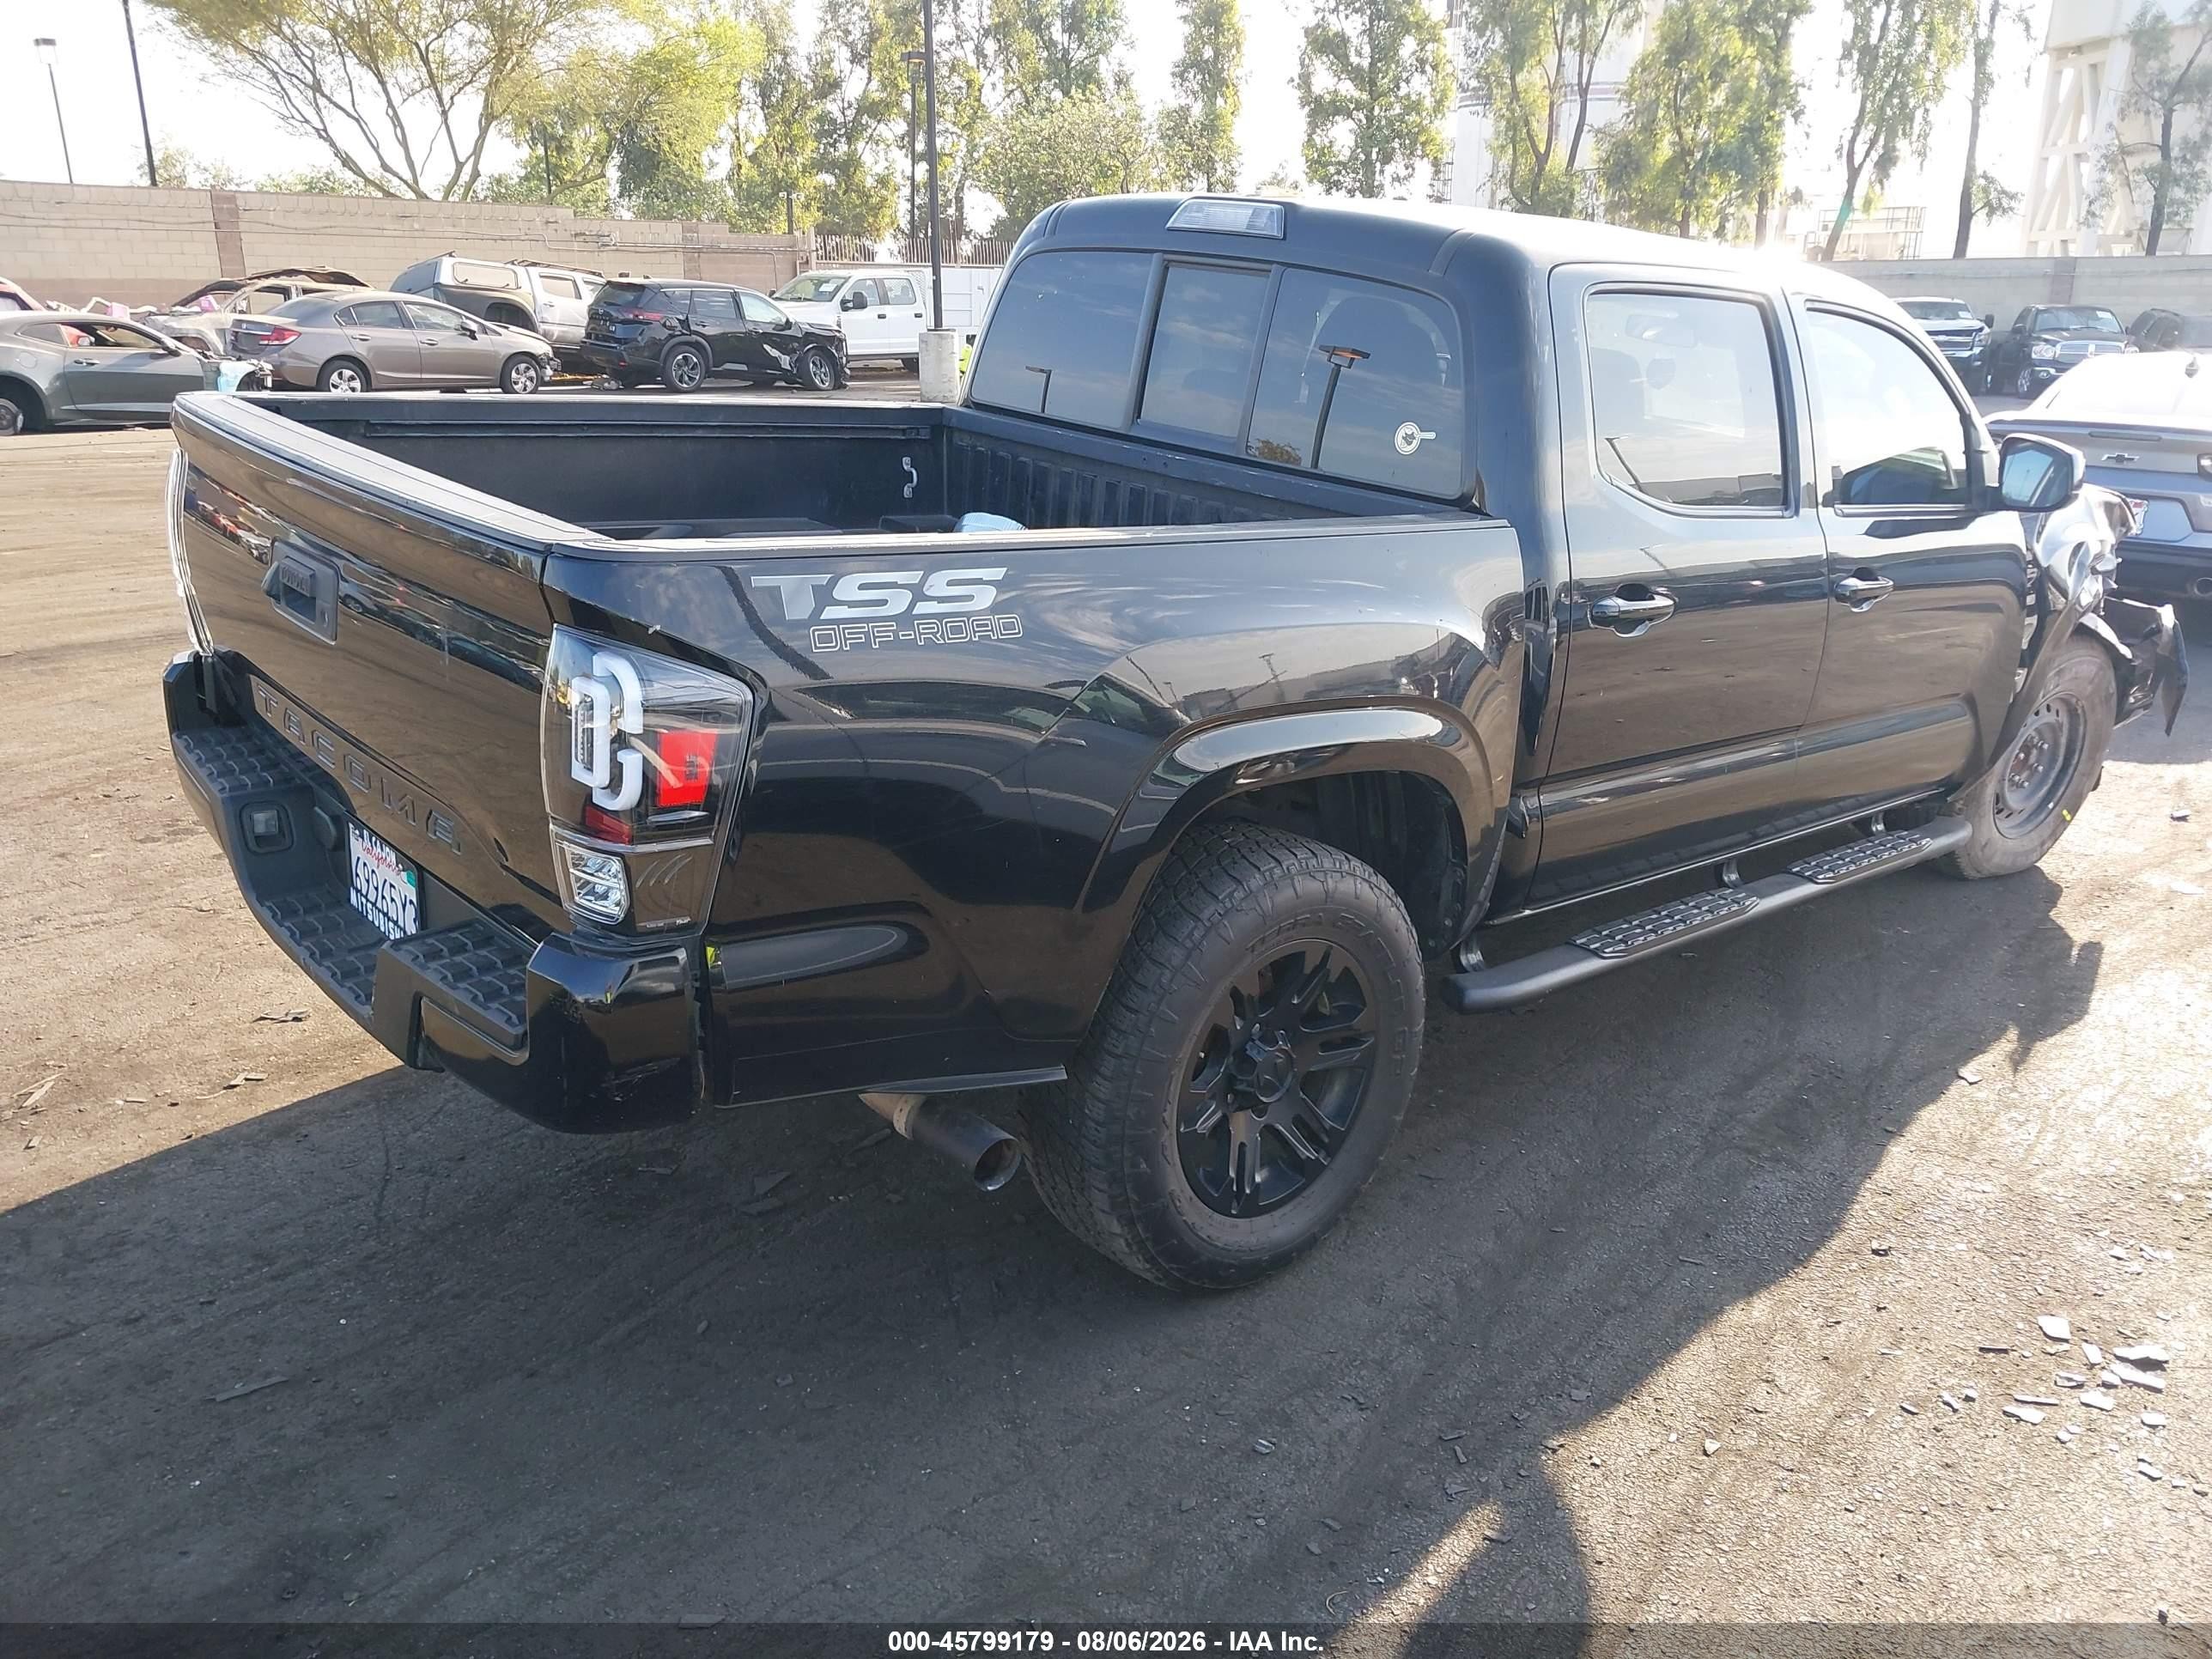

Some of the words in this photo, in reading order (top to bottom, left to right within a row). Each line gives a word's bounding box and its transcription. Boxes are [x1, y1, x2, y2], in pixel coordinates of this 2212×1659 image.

[750, 568, 1008, 621] TSS
[810, 614, 1024, 653] OFF-ROAD
[258, 684, 462, 856] TACOMA
